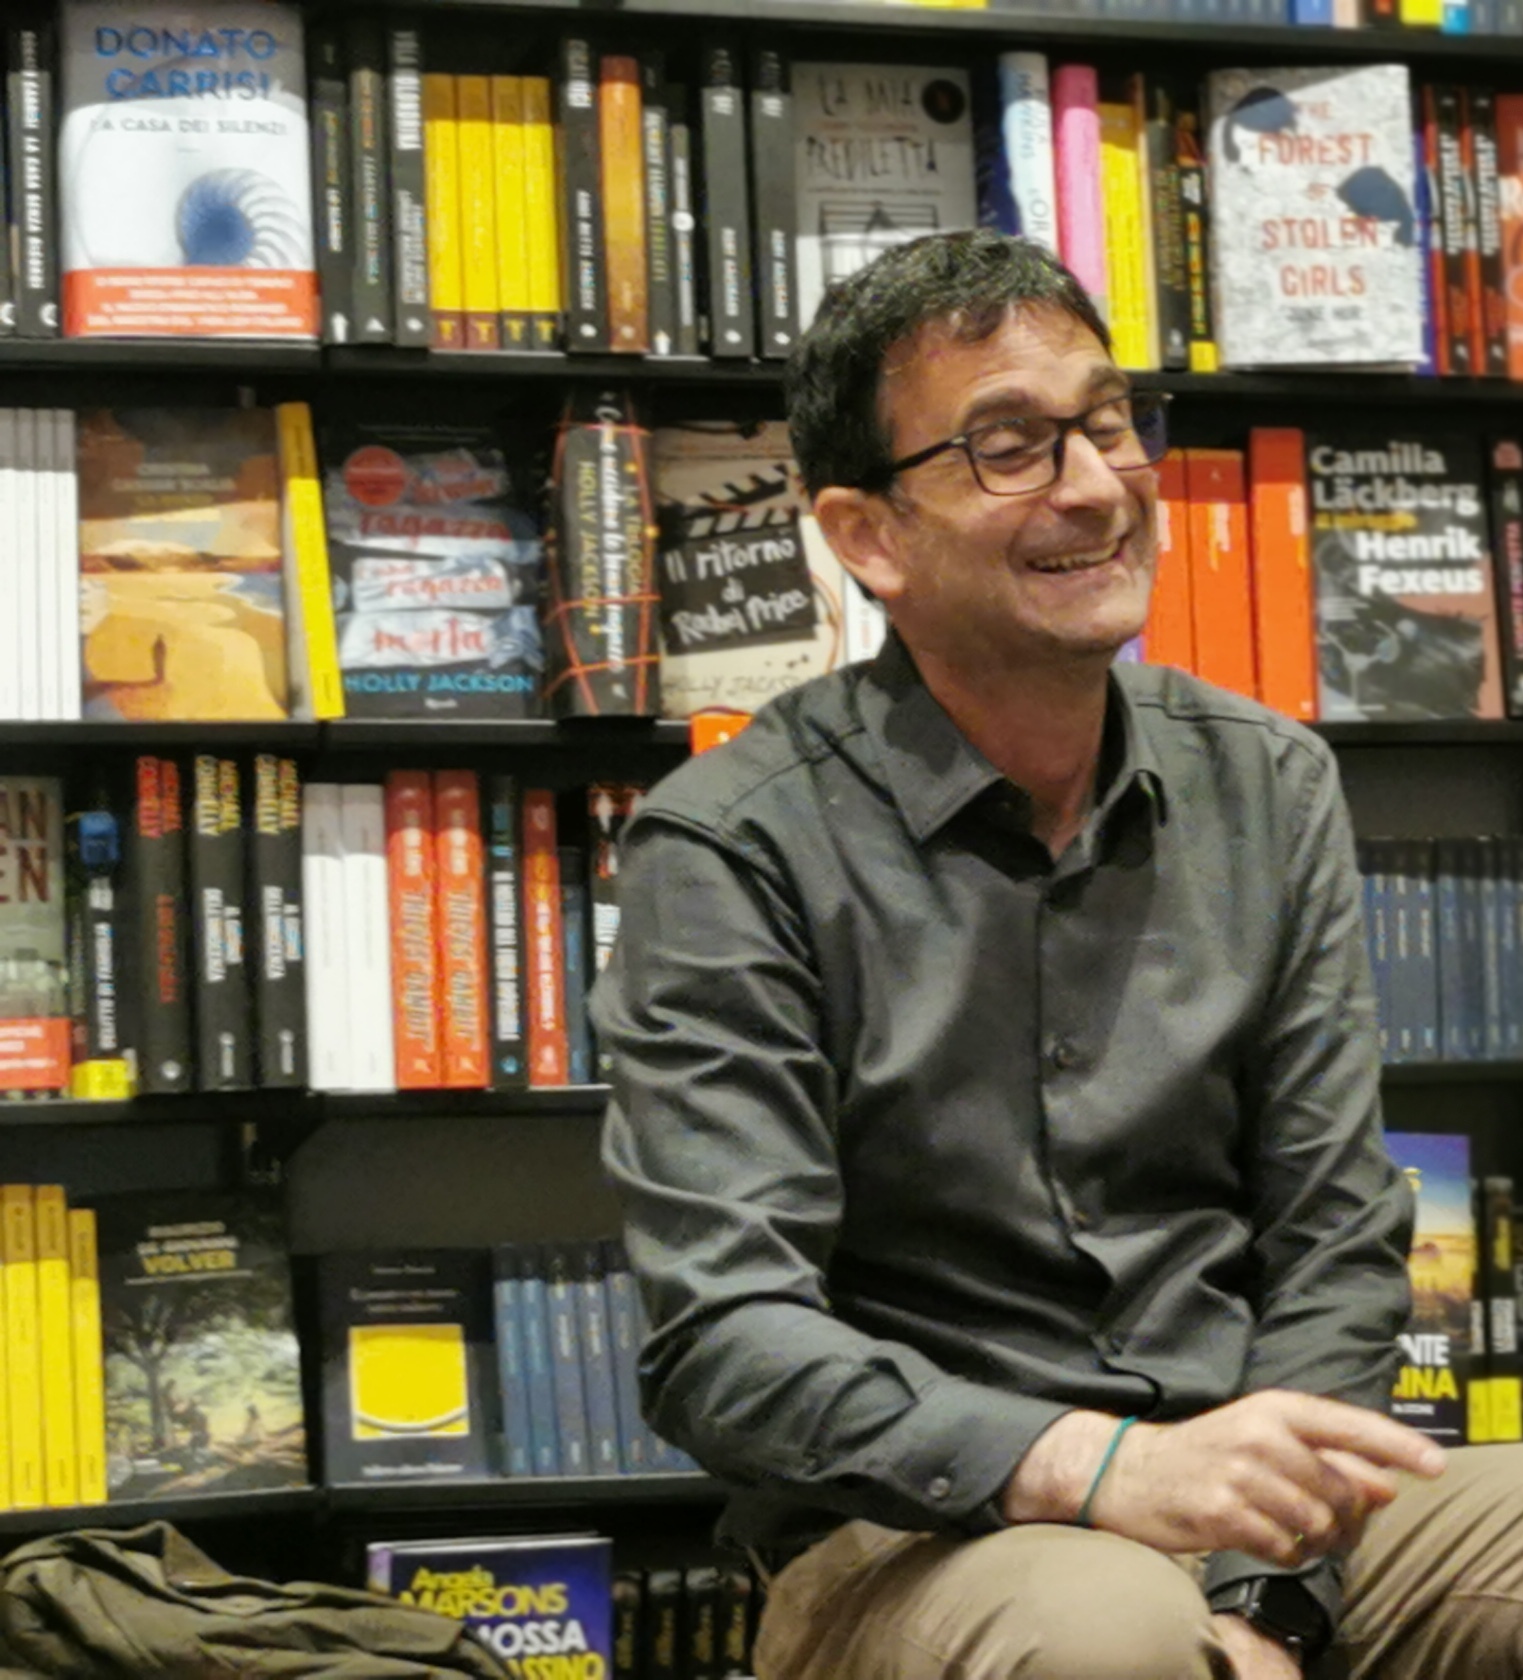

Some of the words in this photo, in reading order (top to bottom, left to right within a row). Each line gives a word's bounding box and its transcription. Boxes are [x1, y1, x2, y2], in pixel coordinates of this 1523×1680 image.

[94, 25, 280, 60] DONATO
[104, 68, 273, 100] CARRISI
[120, 117, 173, 134] CASA
[216, 119, 288, 136] SILENZI
[1257, 131, 1375, 167] FOREST
[1261, 216, 1381, 251] STOLEN
[1280, 263, 1368, 299] GIRLS
[1311, 440, 1446, 475] Camilla
[577, 460, 598, 524] HOLLY
[1312, 478, 1482, 517] Läckberg
[665, 550, 688, 584] Il
[695, 537, 797, 580] ritorno
[1355, 525, 1482, 562] Henrik
[580, 530, 601, 618] JACKSON
[721, 577, 745, 604] di
[1357, 564, 1485, 597] Fexeus
[671, 603, 749, 645] Rachel
[746, 588, 811, 631] Price
[345, 672, 421, 694] HOLLY
[427, 672, 535, 694] JACKSON
[137, 756, 160, 839] CONNELLY
[161, 761, 182, 833] MICHAEL
[196, 755, 219, 837] CONNELLY
[219, 760, 241, 831] MICHAEL
[256, 754, 279, 836] CONNELLY
[279, 759, 300, 829] MICHAEL
[142, 1249, 238, 1275] VOLVER
[1397, 1333, 1449, 1366] NTE
[1392, 1366, 1458, 1400] INA
[411, 1564, 494, 1592] Angela
[401, 1581, 569, 1619] MARSONS
